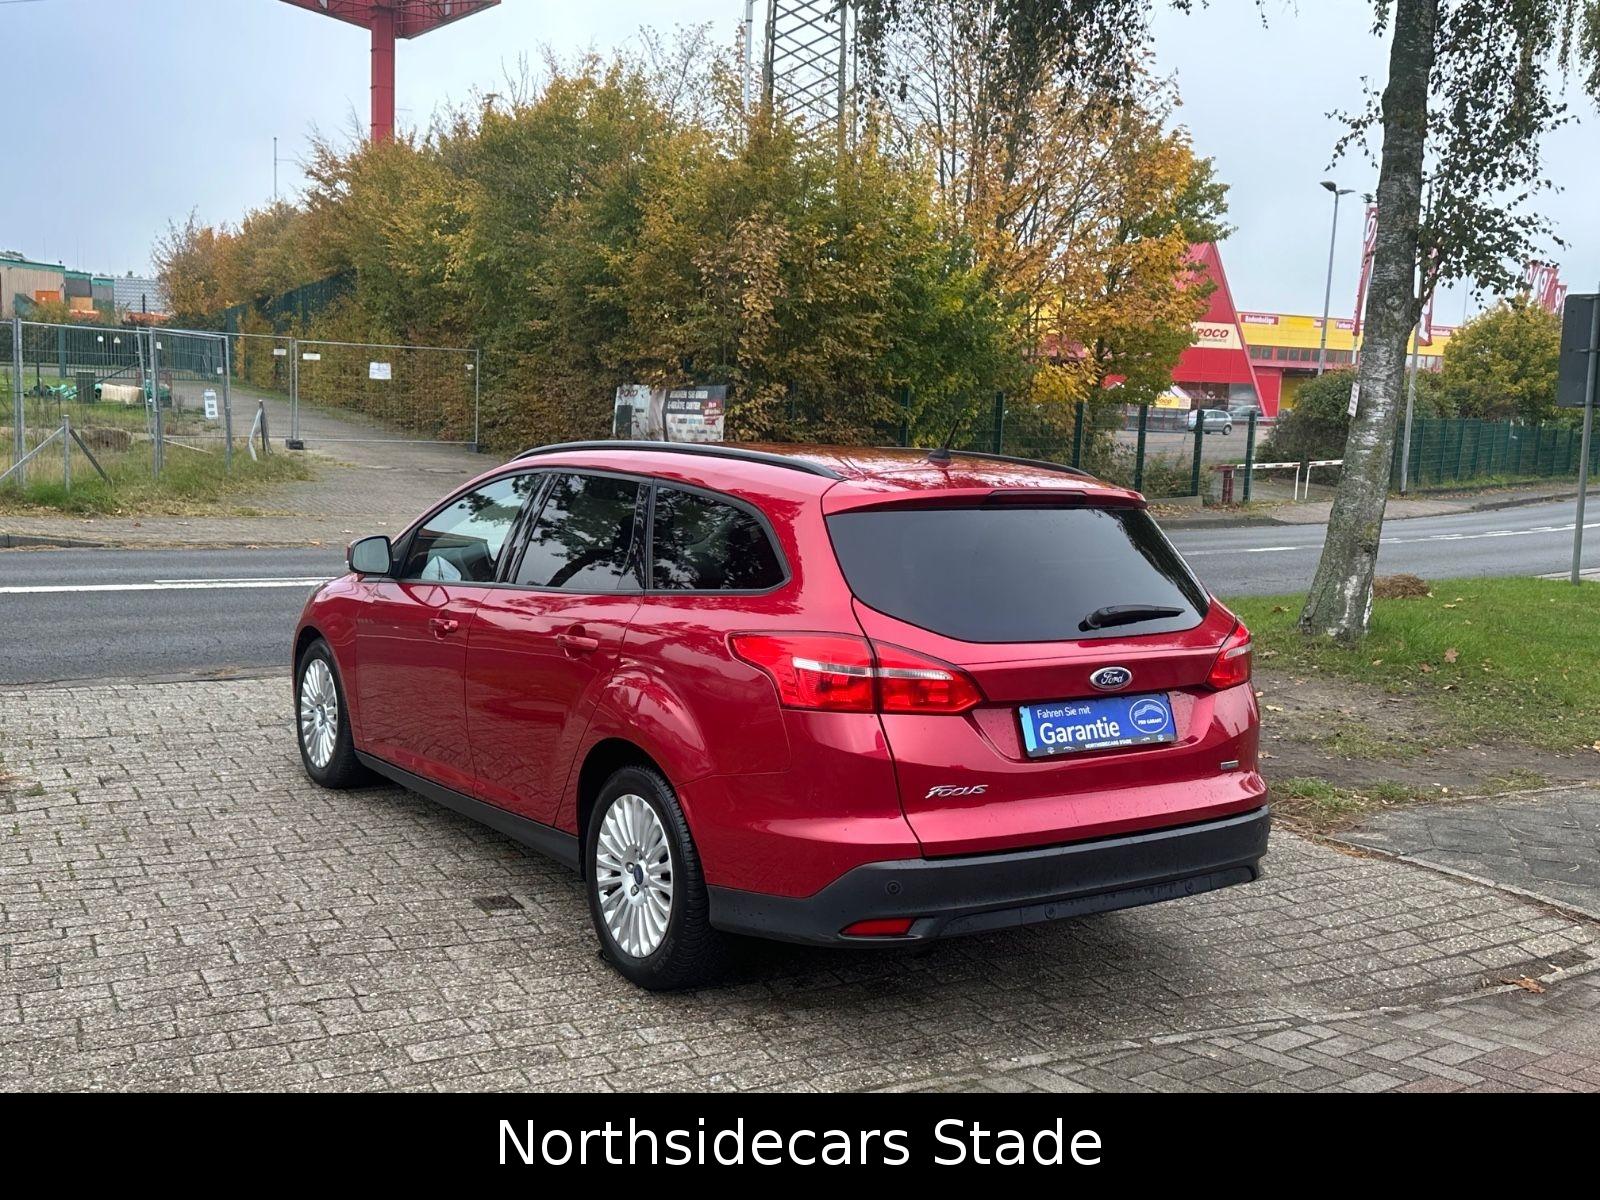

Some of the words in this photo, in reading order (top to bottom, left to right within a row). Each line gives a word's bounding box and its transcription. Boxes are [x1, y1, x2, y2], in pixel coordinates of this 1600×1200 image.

[1197, 328, 1229, 338] POCO
[1101, 671, 1124, 684] Ford
[1037, 709, 1064, 719] Fahren
[1065, 706, 1077, 716] Sie
[1078, 704, 1091, 714] mit
[1040, 716, 1120, 744] Garantie
